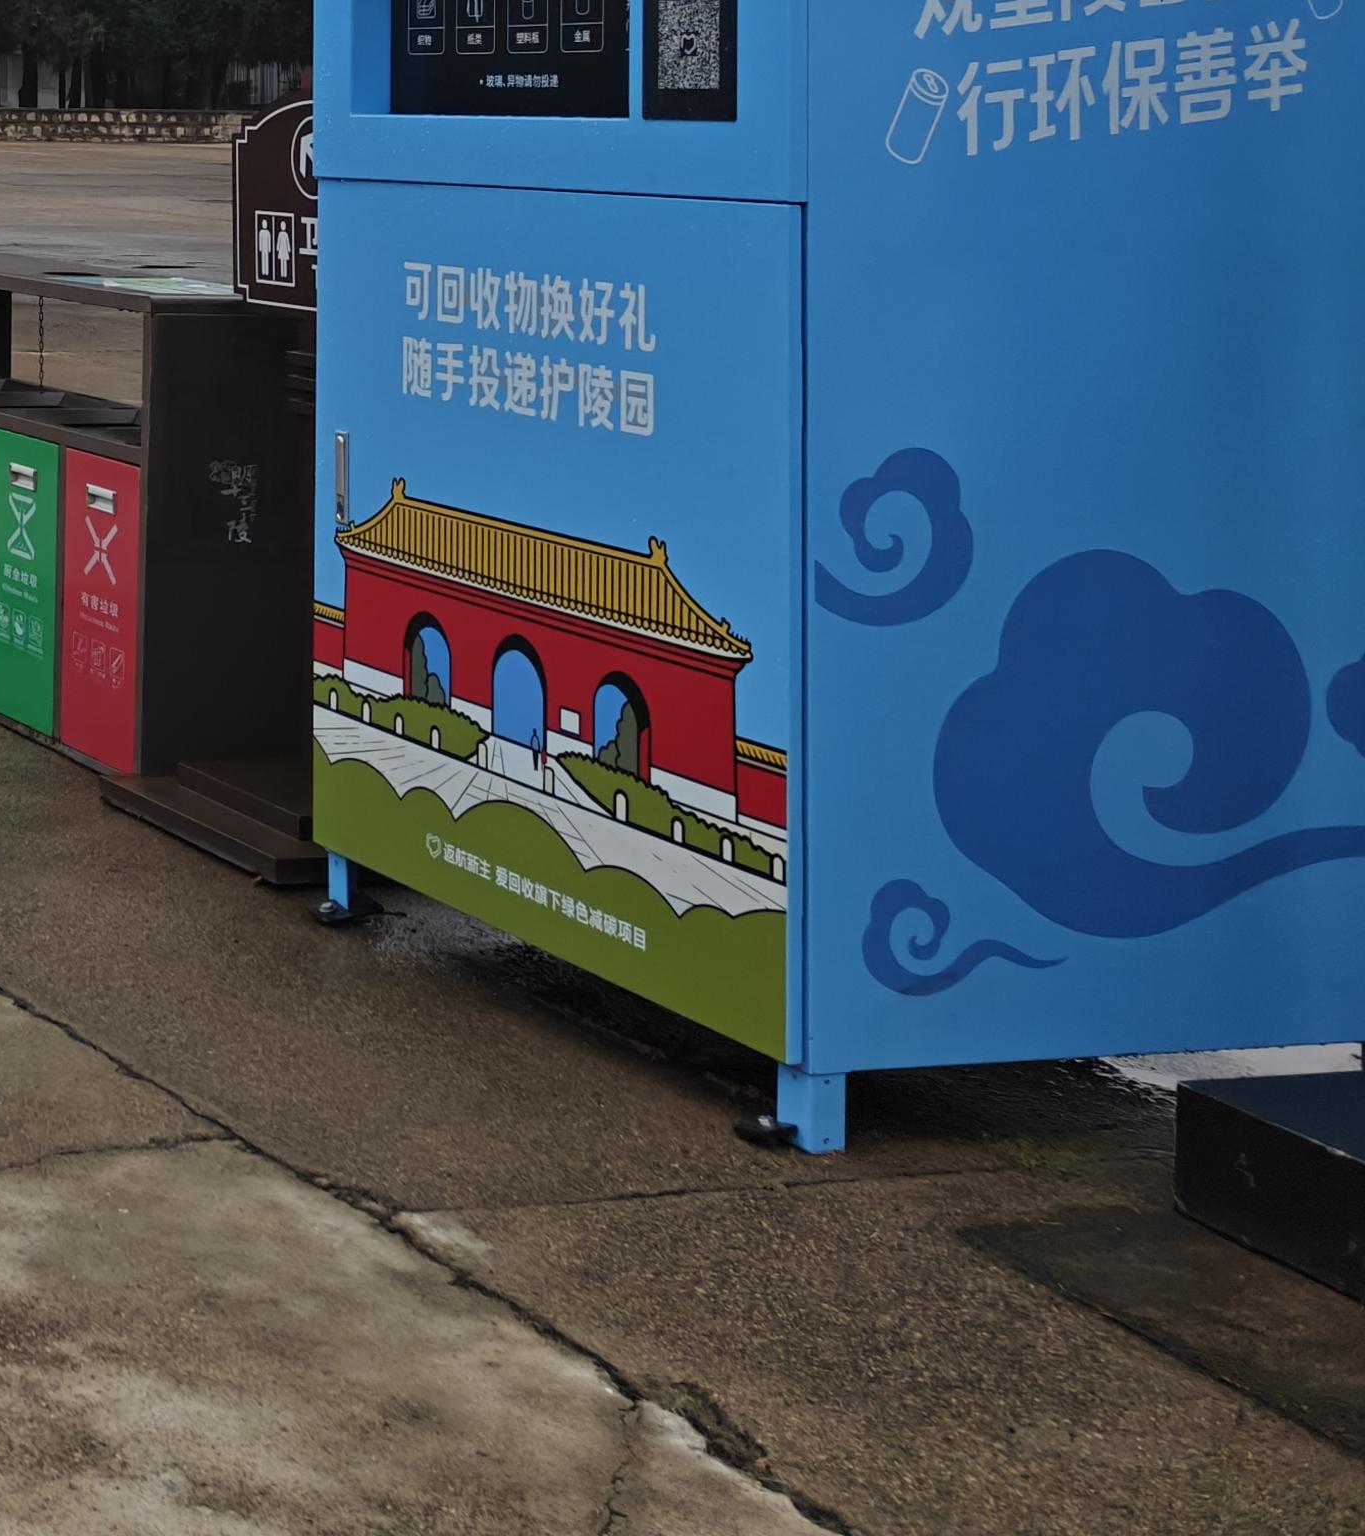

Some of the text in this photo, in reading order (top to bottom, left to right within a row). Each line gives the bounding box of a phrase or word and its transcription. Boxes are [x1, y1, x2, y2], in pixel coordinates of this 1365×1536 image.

[515, 31, 540, 45] 塑料瓶
[573, 29, 591, 44] 金属
[956, 17, 1308, 156] 行环保善举
[403, 260, 657, 353] 可回收物换好礼
[401, 336, 655, 437] 随手投递护陵园
[80, 591, 119, 618] 有害垃圾
[495, 865, 647, 953] 爱回收旗下绿色减碳项目
